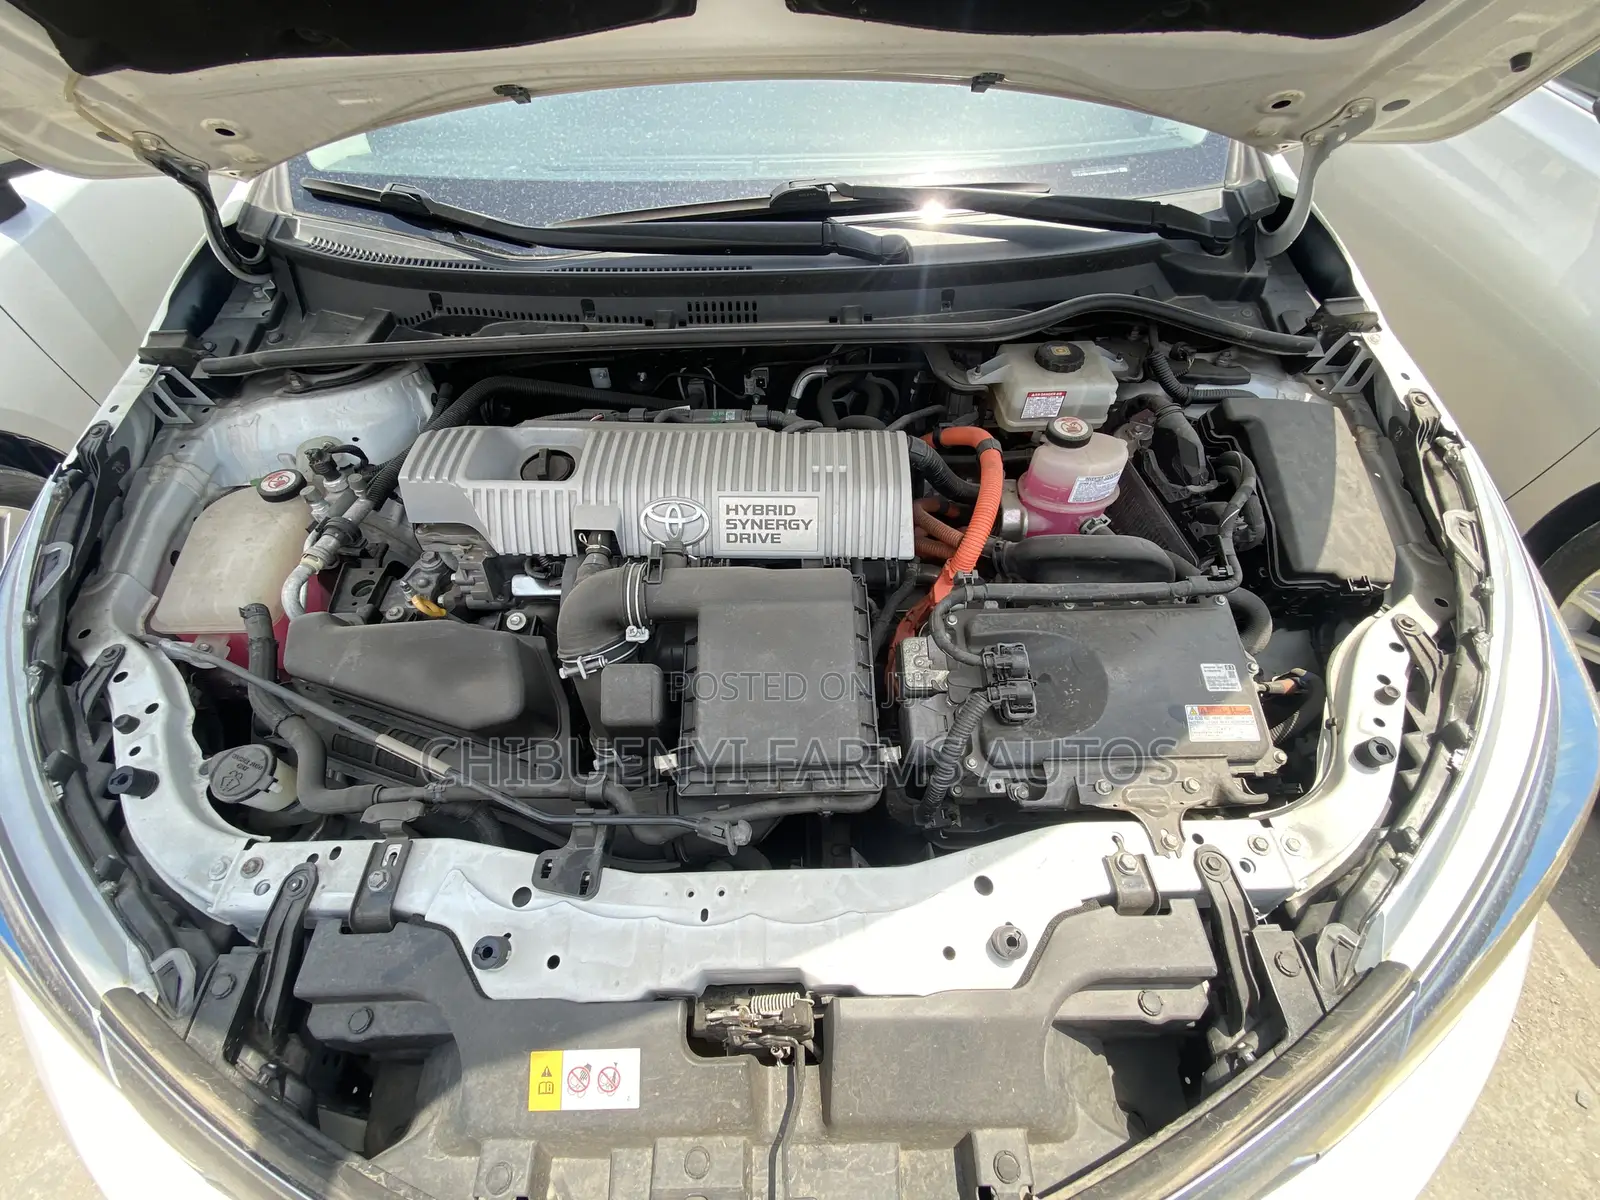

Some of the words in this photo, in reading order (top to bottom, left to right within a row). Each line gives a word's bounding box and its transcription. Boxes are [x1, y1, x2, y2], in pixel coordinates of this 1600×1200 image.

[725, 504, 797, 516] HYBRID
[725, 519, 813, 531] SYNERGY
[726, 533, 782, 544] DRIVE
